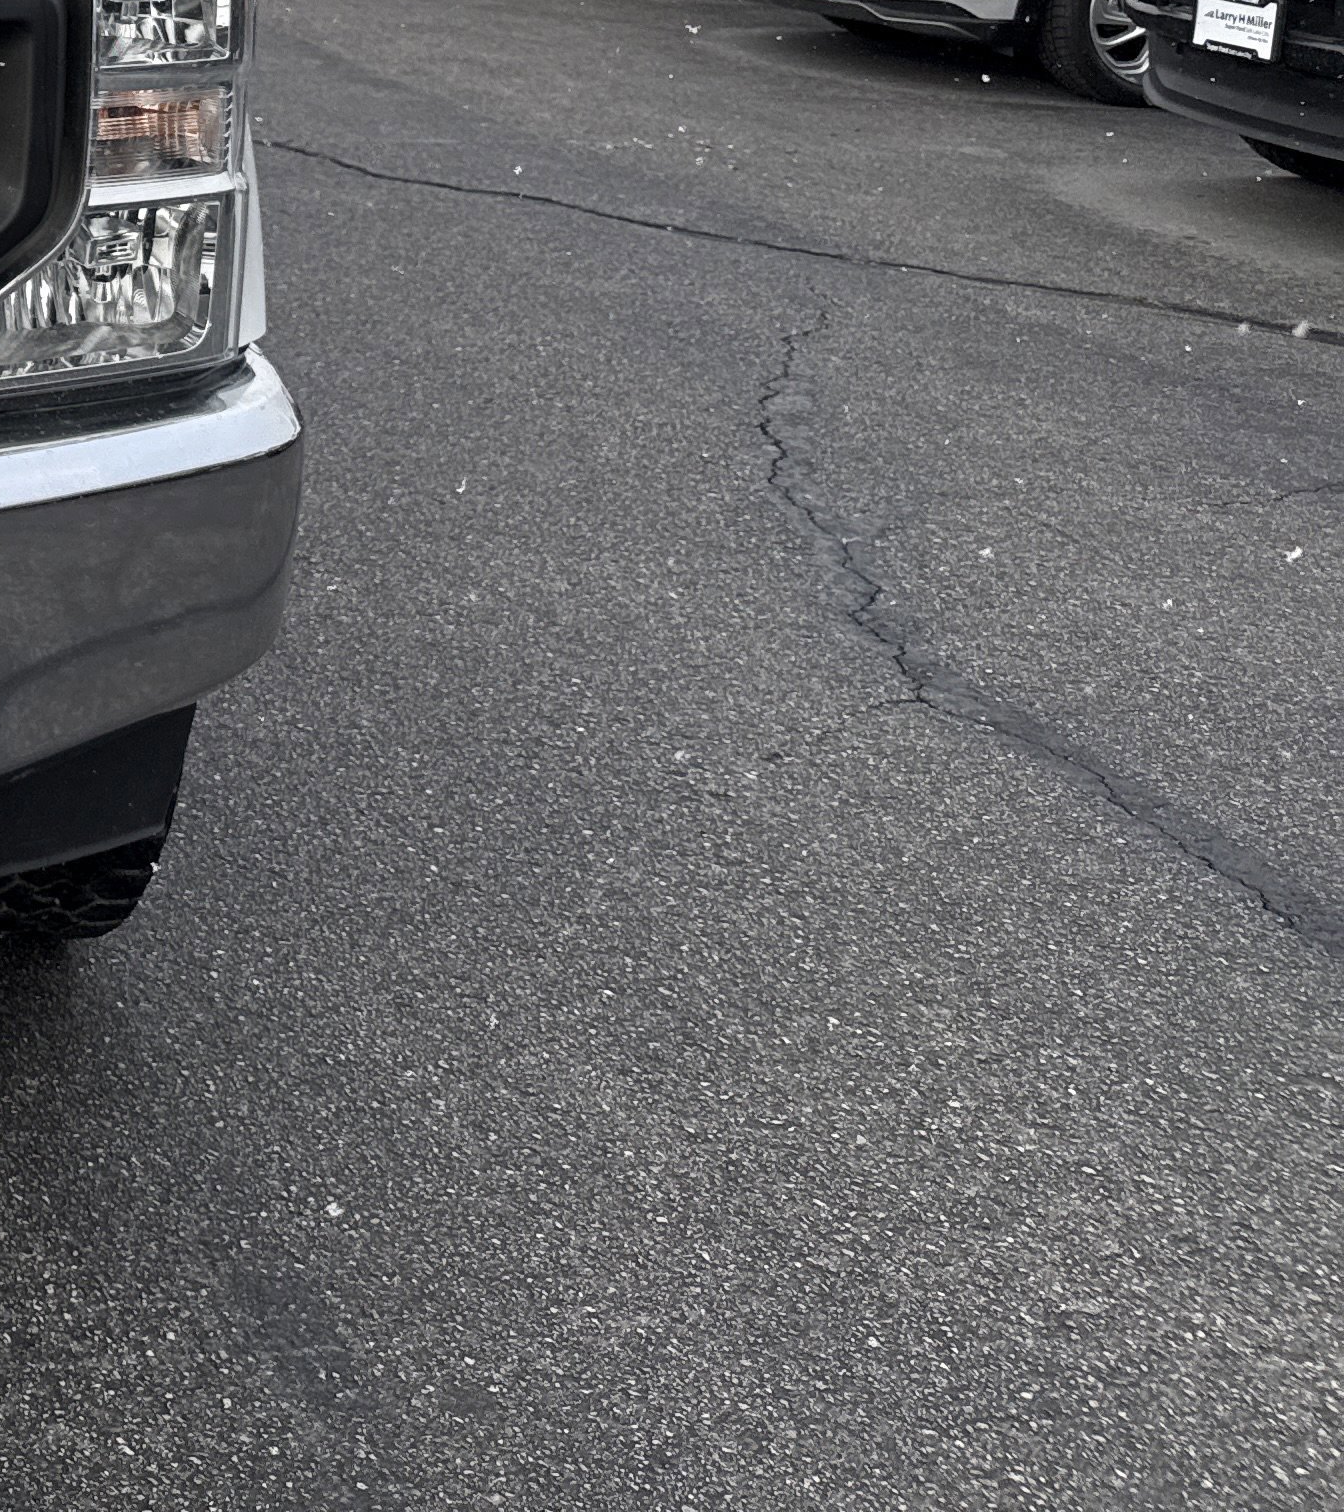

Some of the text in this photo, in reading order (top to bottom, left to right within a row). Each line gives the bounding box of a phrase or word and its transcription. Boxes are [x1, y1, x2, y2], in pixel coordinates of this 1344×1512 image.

[1215, 9, 1272, 29] Larry H Miller
